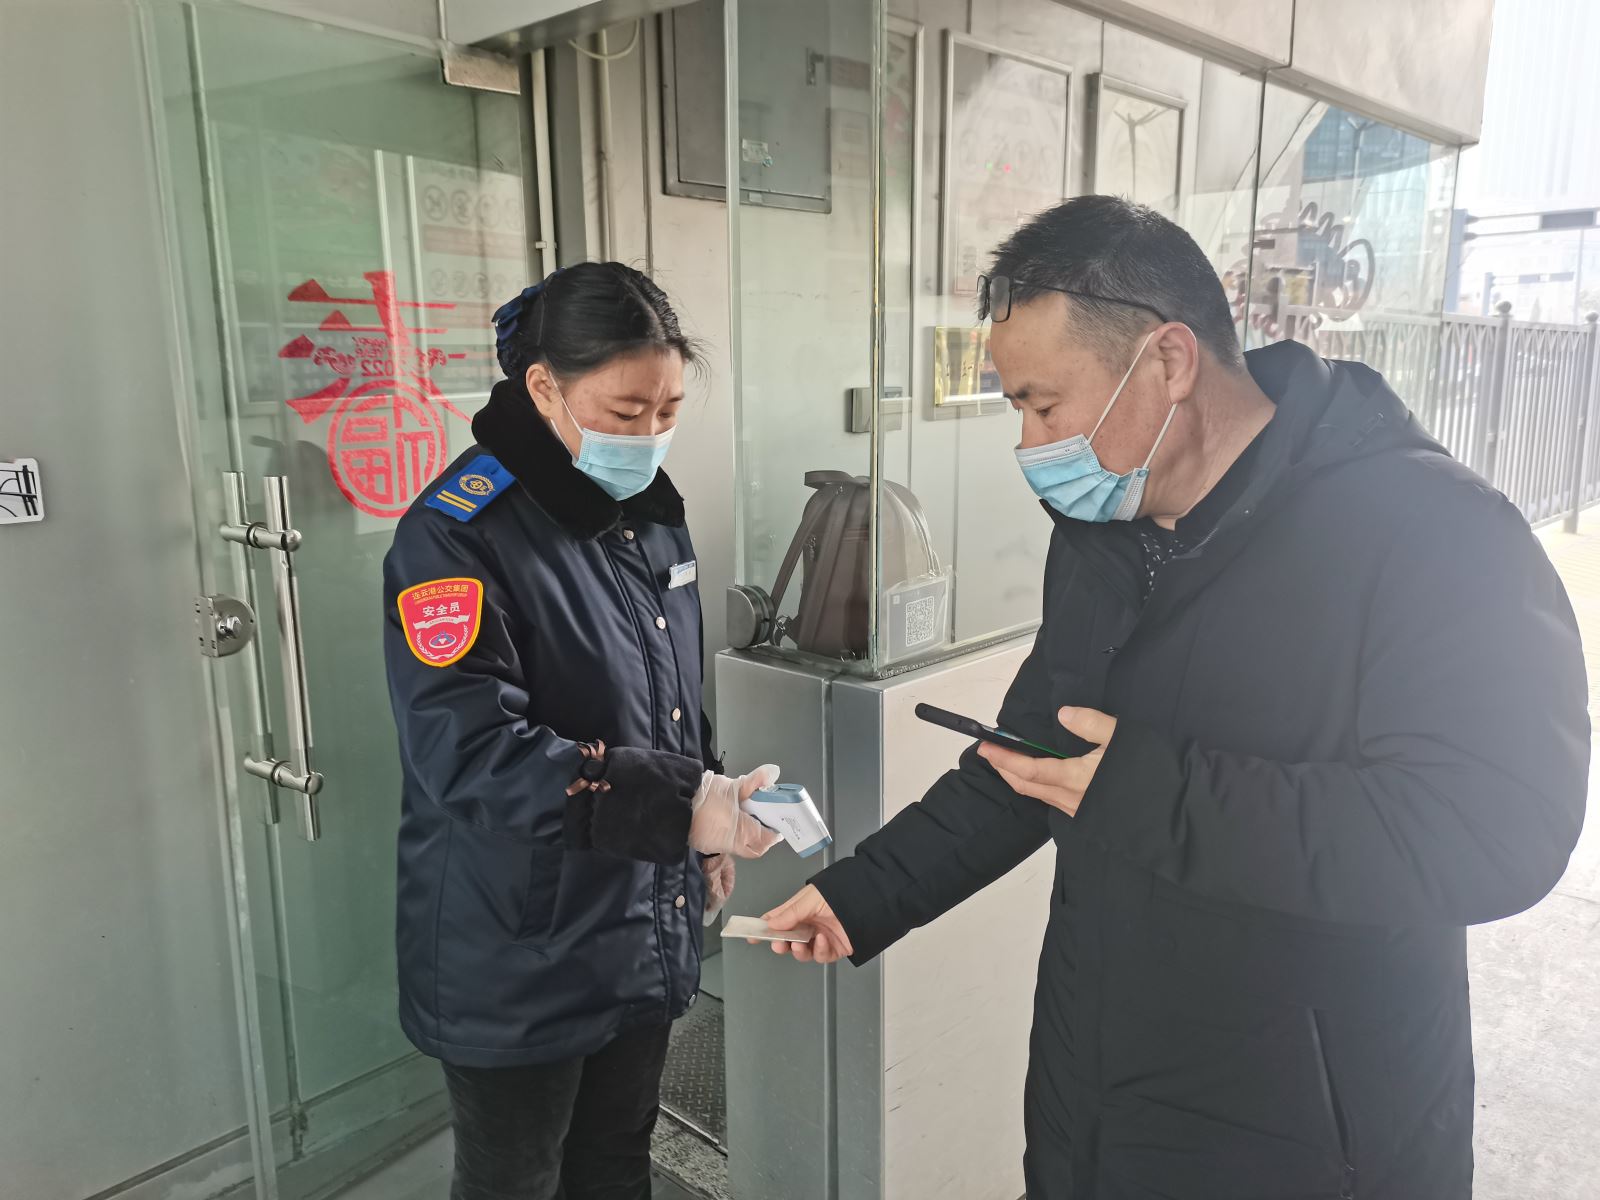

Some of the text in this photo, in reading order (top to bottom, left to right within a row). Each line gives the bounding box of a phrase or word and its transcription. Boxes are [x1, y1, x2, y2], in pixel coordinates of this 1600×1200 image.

[412, 584, 469, 600] 连云港公交集团
[422, 601, 460, 618] 安全员
